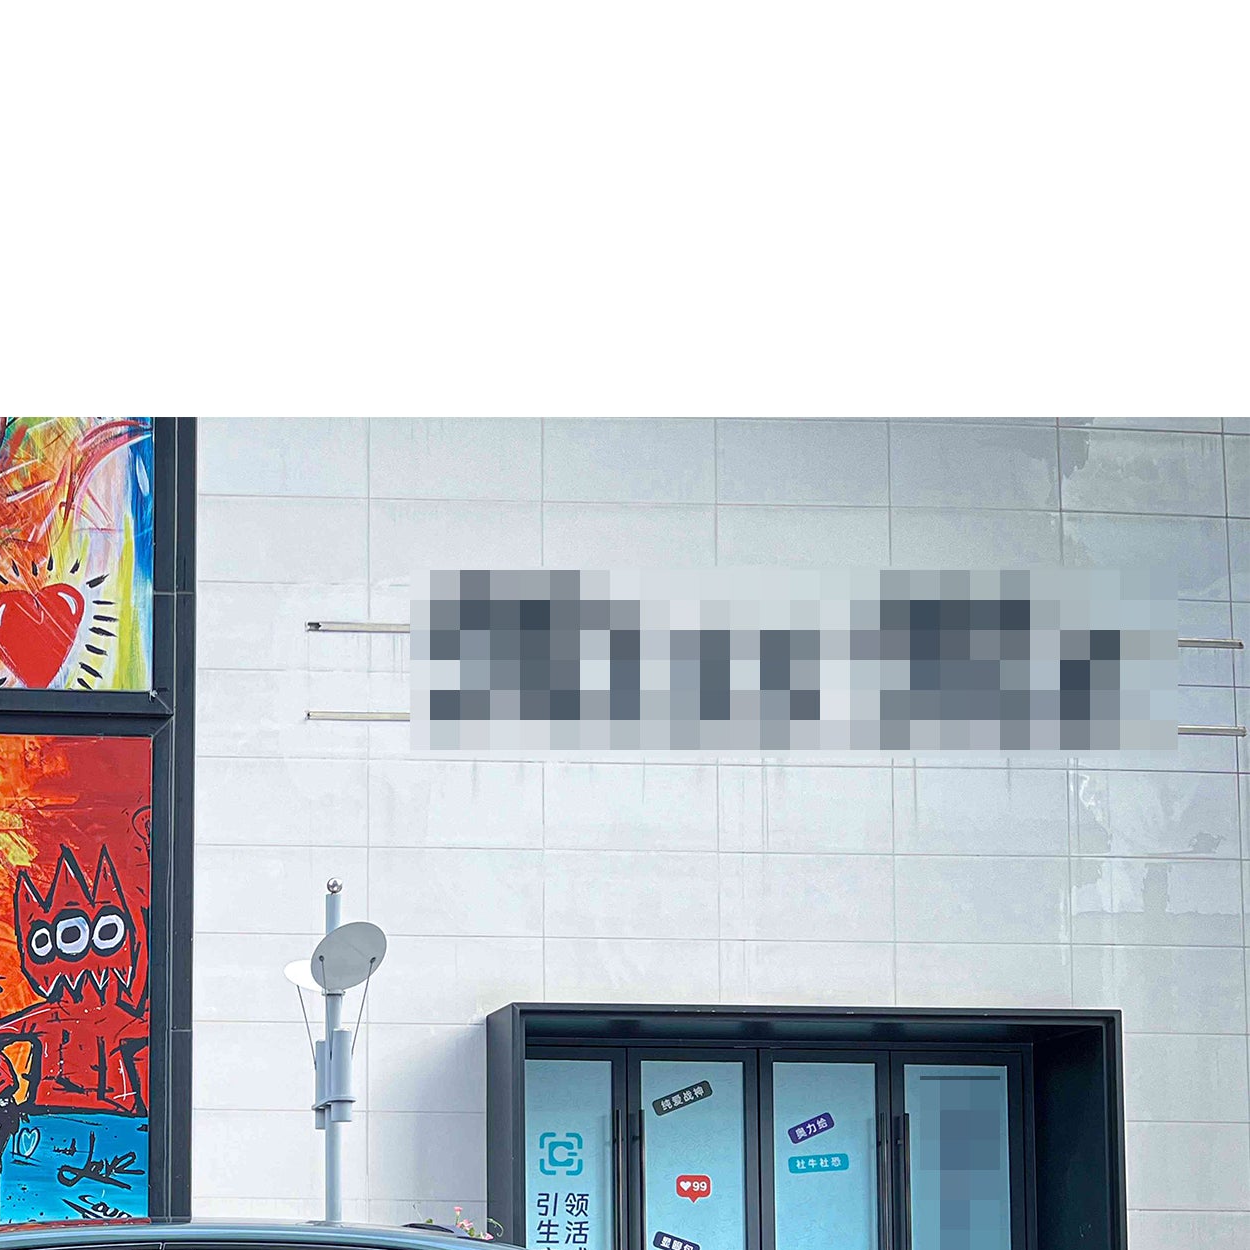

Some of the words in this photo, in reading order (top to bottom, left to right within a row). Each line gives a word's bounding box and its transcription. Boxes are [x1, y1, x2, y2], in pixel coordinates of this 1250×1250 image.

[795, 1117, 828, 1140] 奥力给
[796, 1156, 842, 1170] 社牛社恐
[692, 1181, 708, 1192] 99
[537, 1192, 589, 1218] 引领
[536, 1219, 589, 1244] 生活
